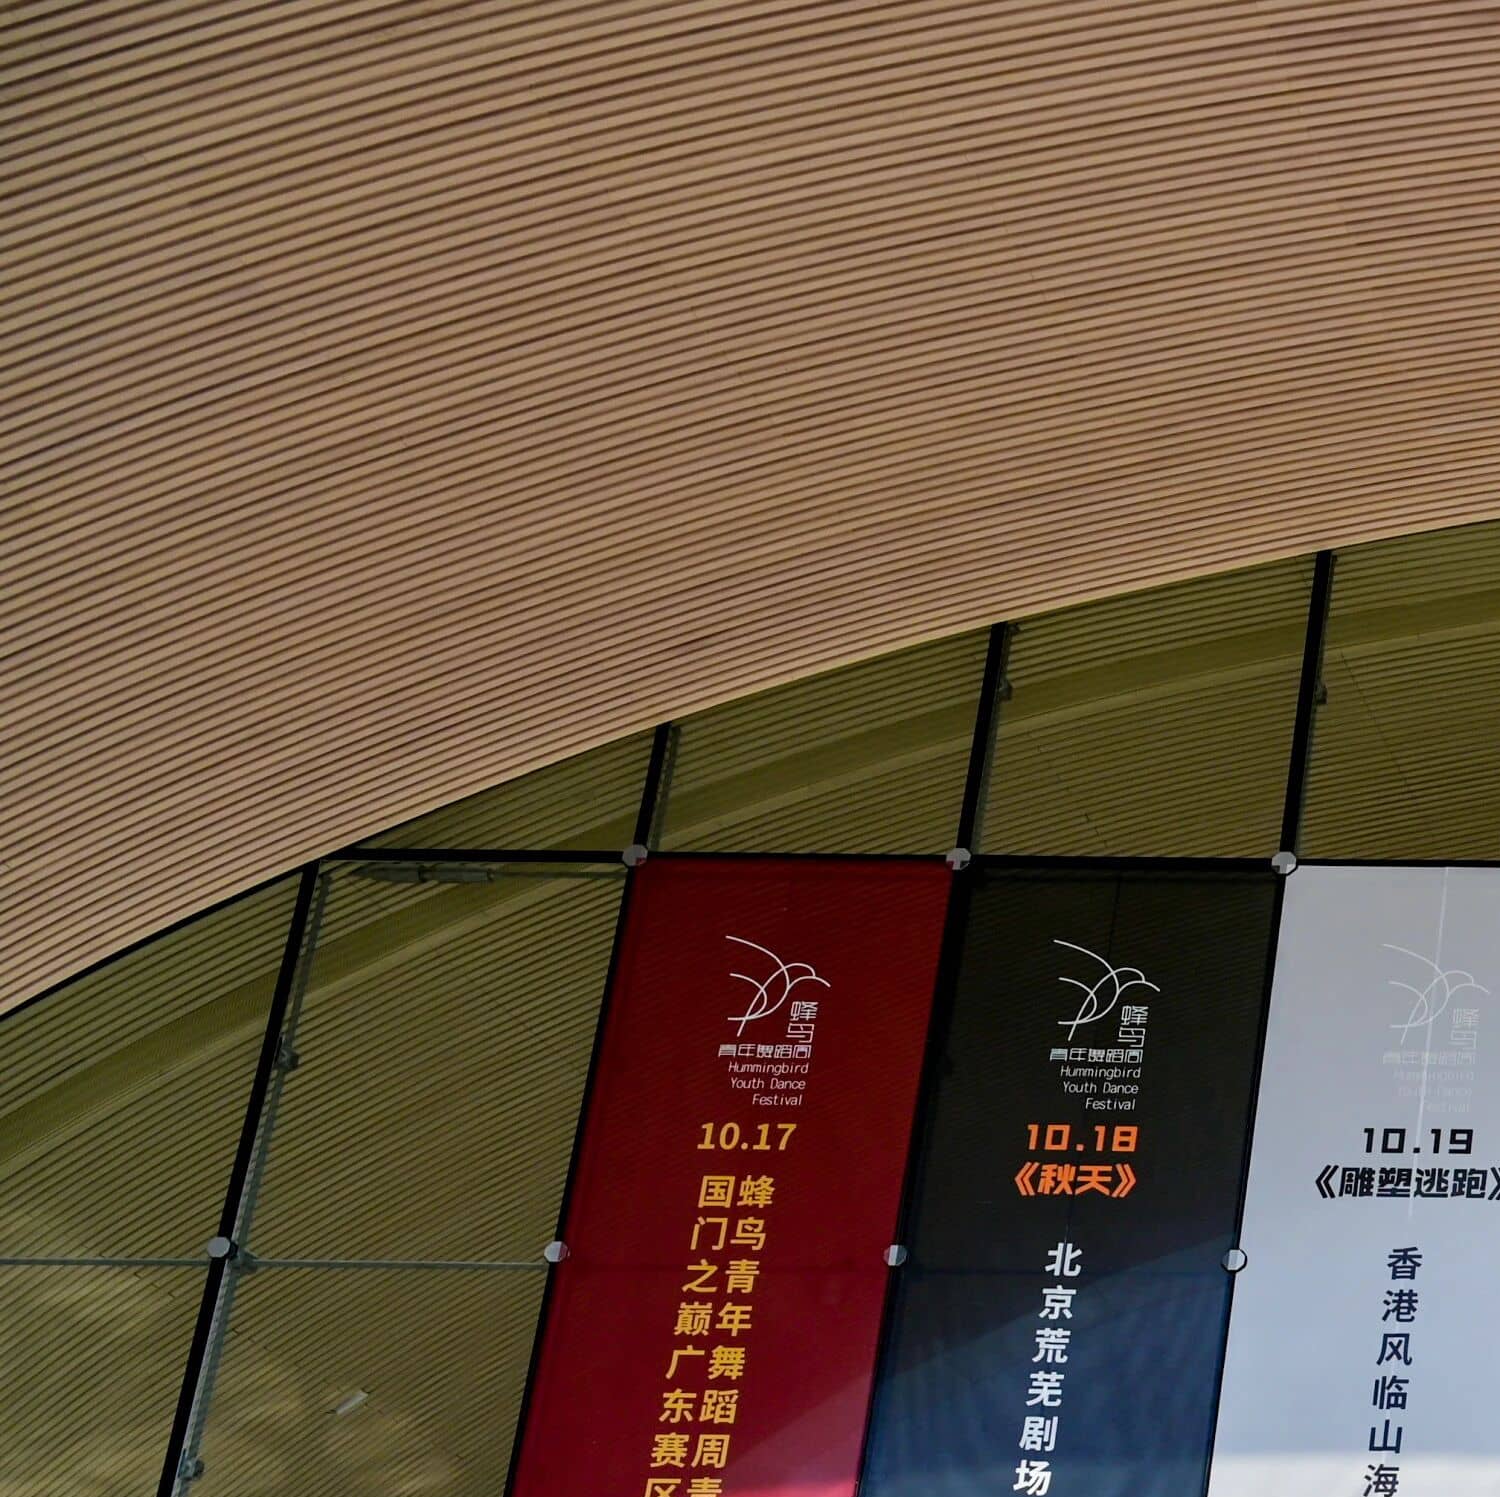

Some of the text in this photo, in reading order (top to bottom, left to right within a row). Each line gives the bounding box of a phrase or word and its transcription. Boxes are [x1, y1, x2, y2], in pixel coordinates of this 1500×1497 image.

[786, 1001, 818, 1043] 蜂鸟
[1119, 1006, 1149, 1046] 蜂鸟
[729, 1062, 808, 1076] Hummingbird
[1060, 1064, 1141, 1080] Hummingbird
[730, 1078, 806, 1090] Youth Dance
[1063, 1081, 1139, 1094] Youth Dance
[753, 1094, 802, 1106] Festival
[1085, 1097, 1136, 1110] Festival
[697, 1123, 797, 1152] 10.17
[1025, 1124, 1138, 1153] 10.18
[1362, 1128, 1473, 1155] 10.19
[1014, 1162, 1137, 1199] 《秋天》
[1014, 1243, 1082, 1497] 北京荒芜剧场
